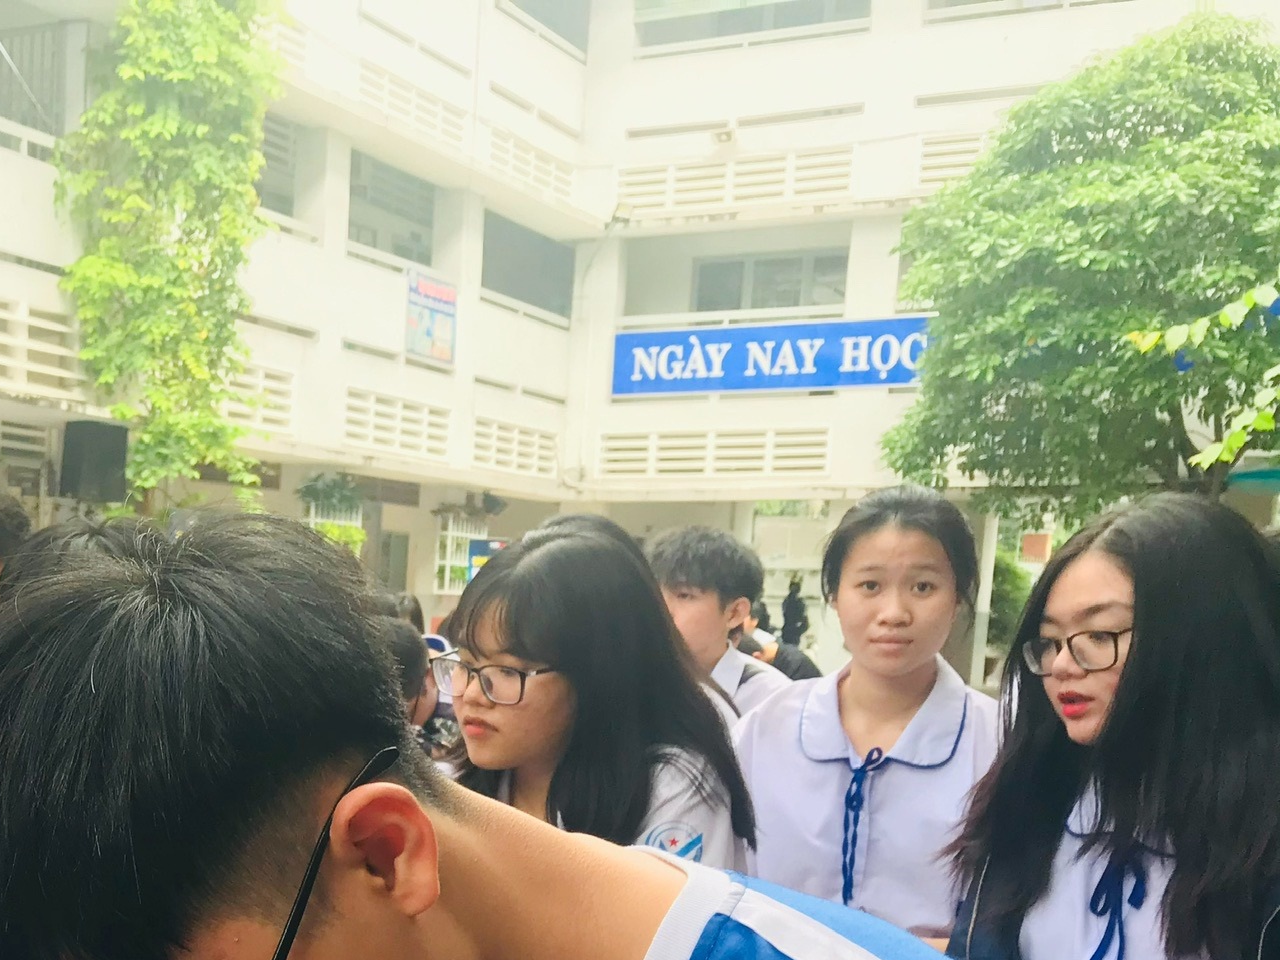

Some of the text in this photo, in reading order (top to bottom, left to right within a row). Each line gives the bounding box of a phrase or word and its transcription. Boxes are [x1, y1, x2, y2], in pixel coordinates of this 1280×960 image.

[630, 332, 928, 381] NGÀY NAY HỌC
